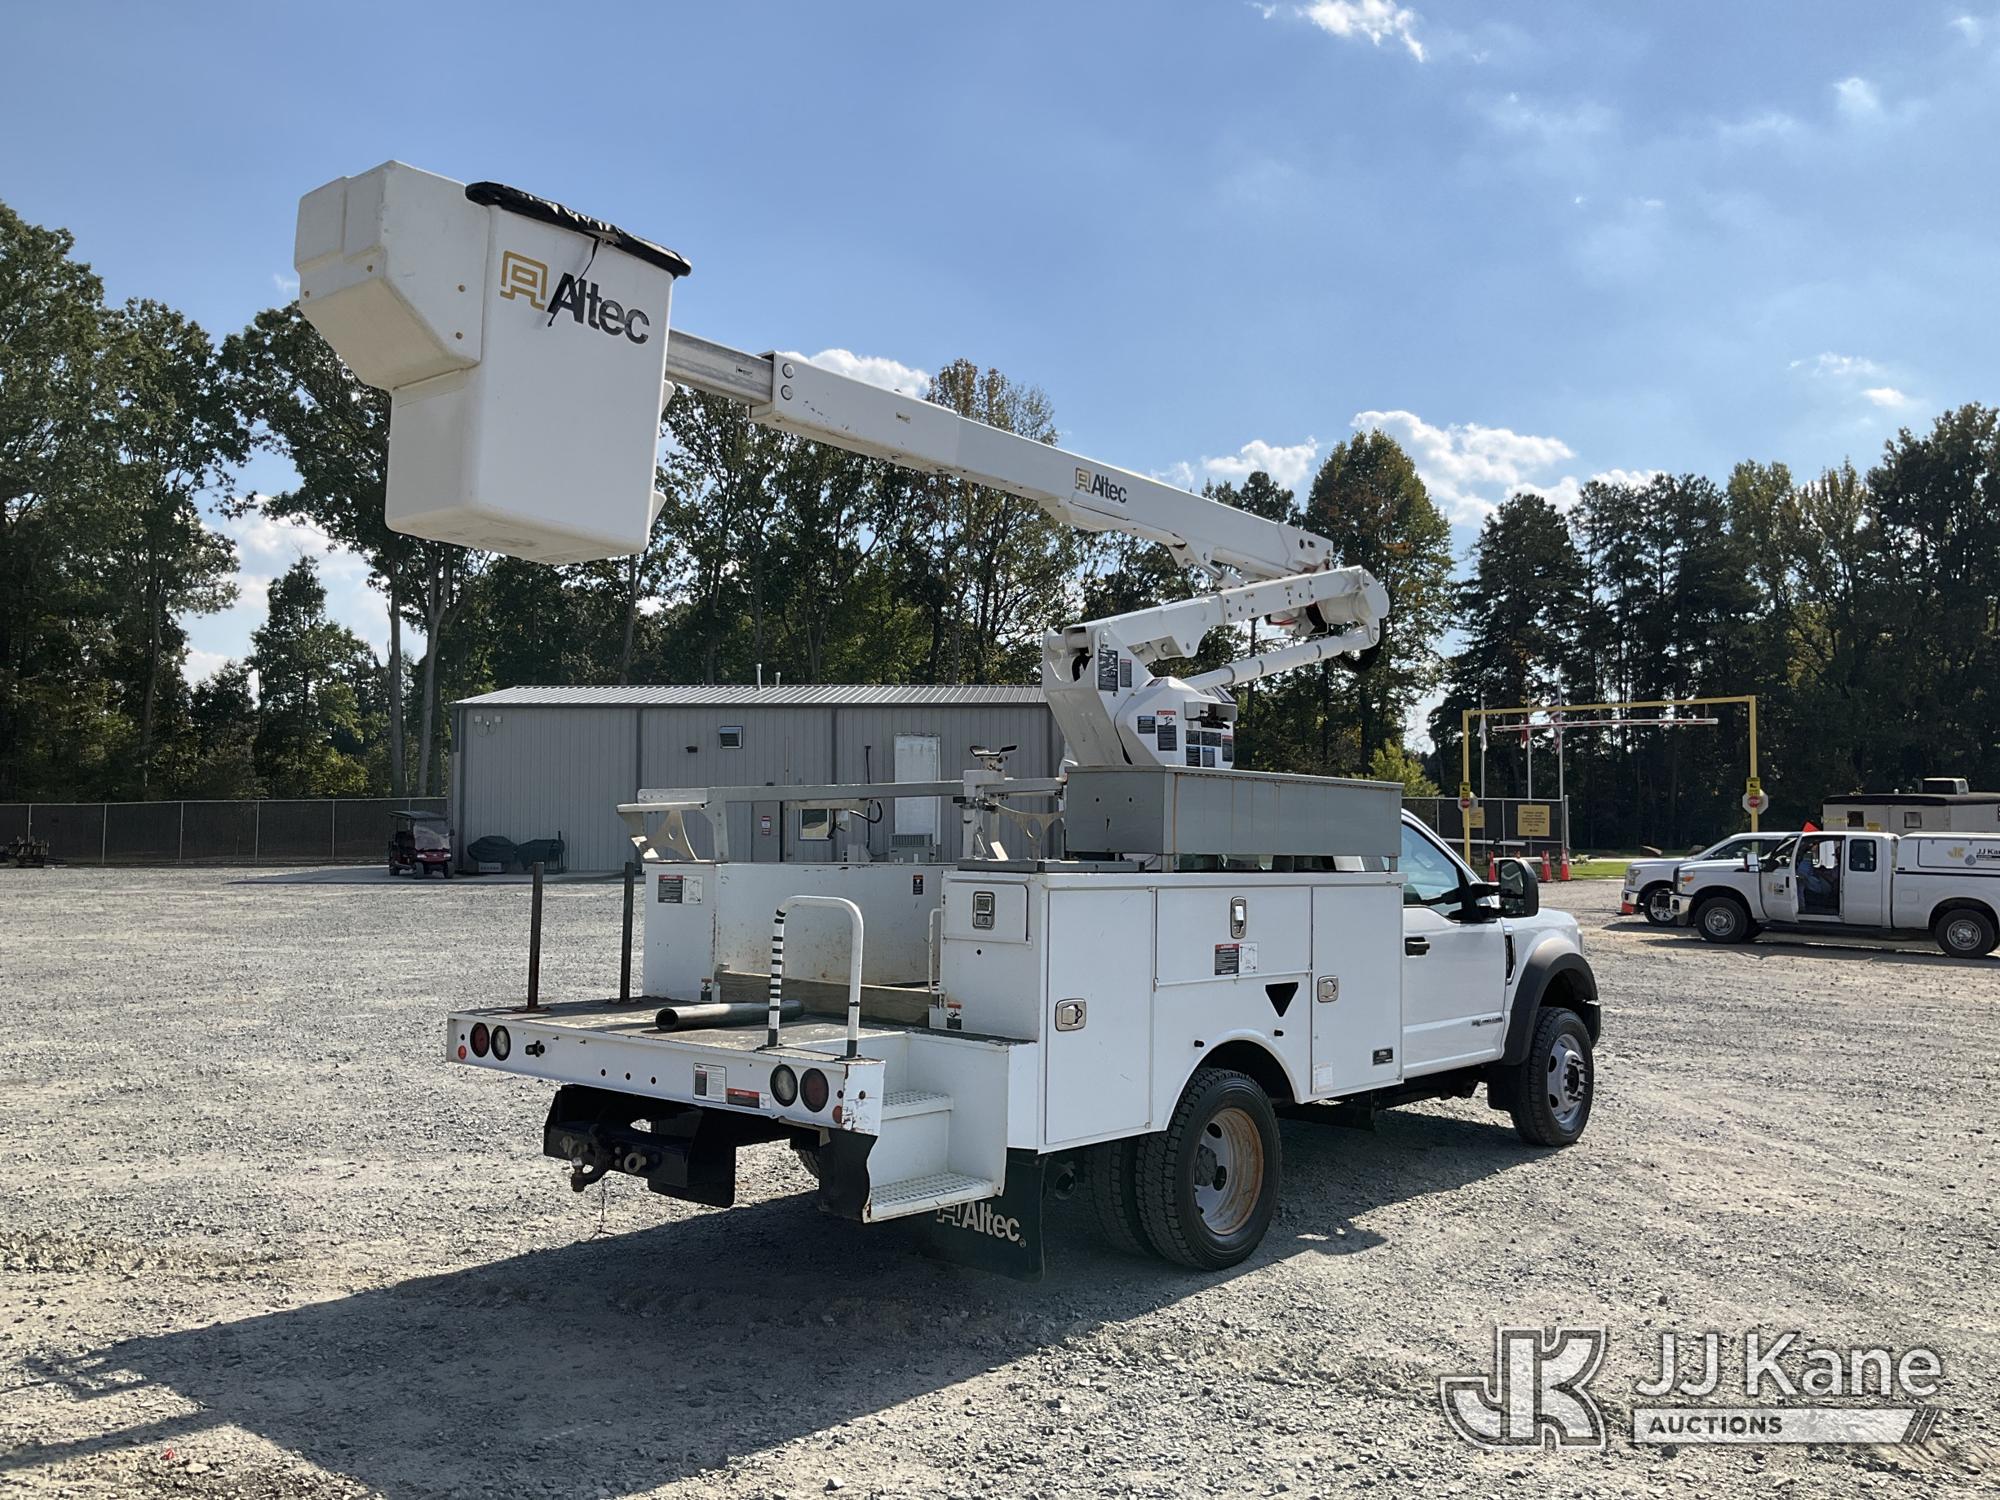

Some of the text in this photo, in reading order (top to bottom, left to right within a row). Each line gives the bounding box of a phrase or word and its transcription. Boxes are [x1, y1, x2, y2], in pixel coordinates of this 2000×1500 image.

[547, 272, 650, 344] Altec
[1091, 474, 1127, 503] Altec
[962, 1200, 1020, 1242] Altec
